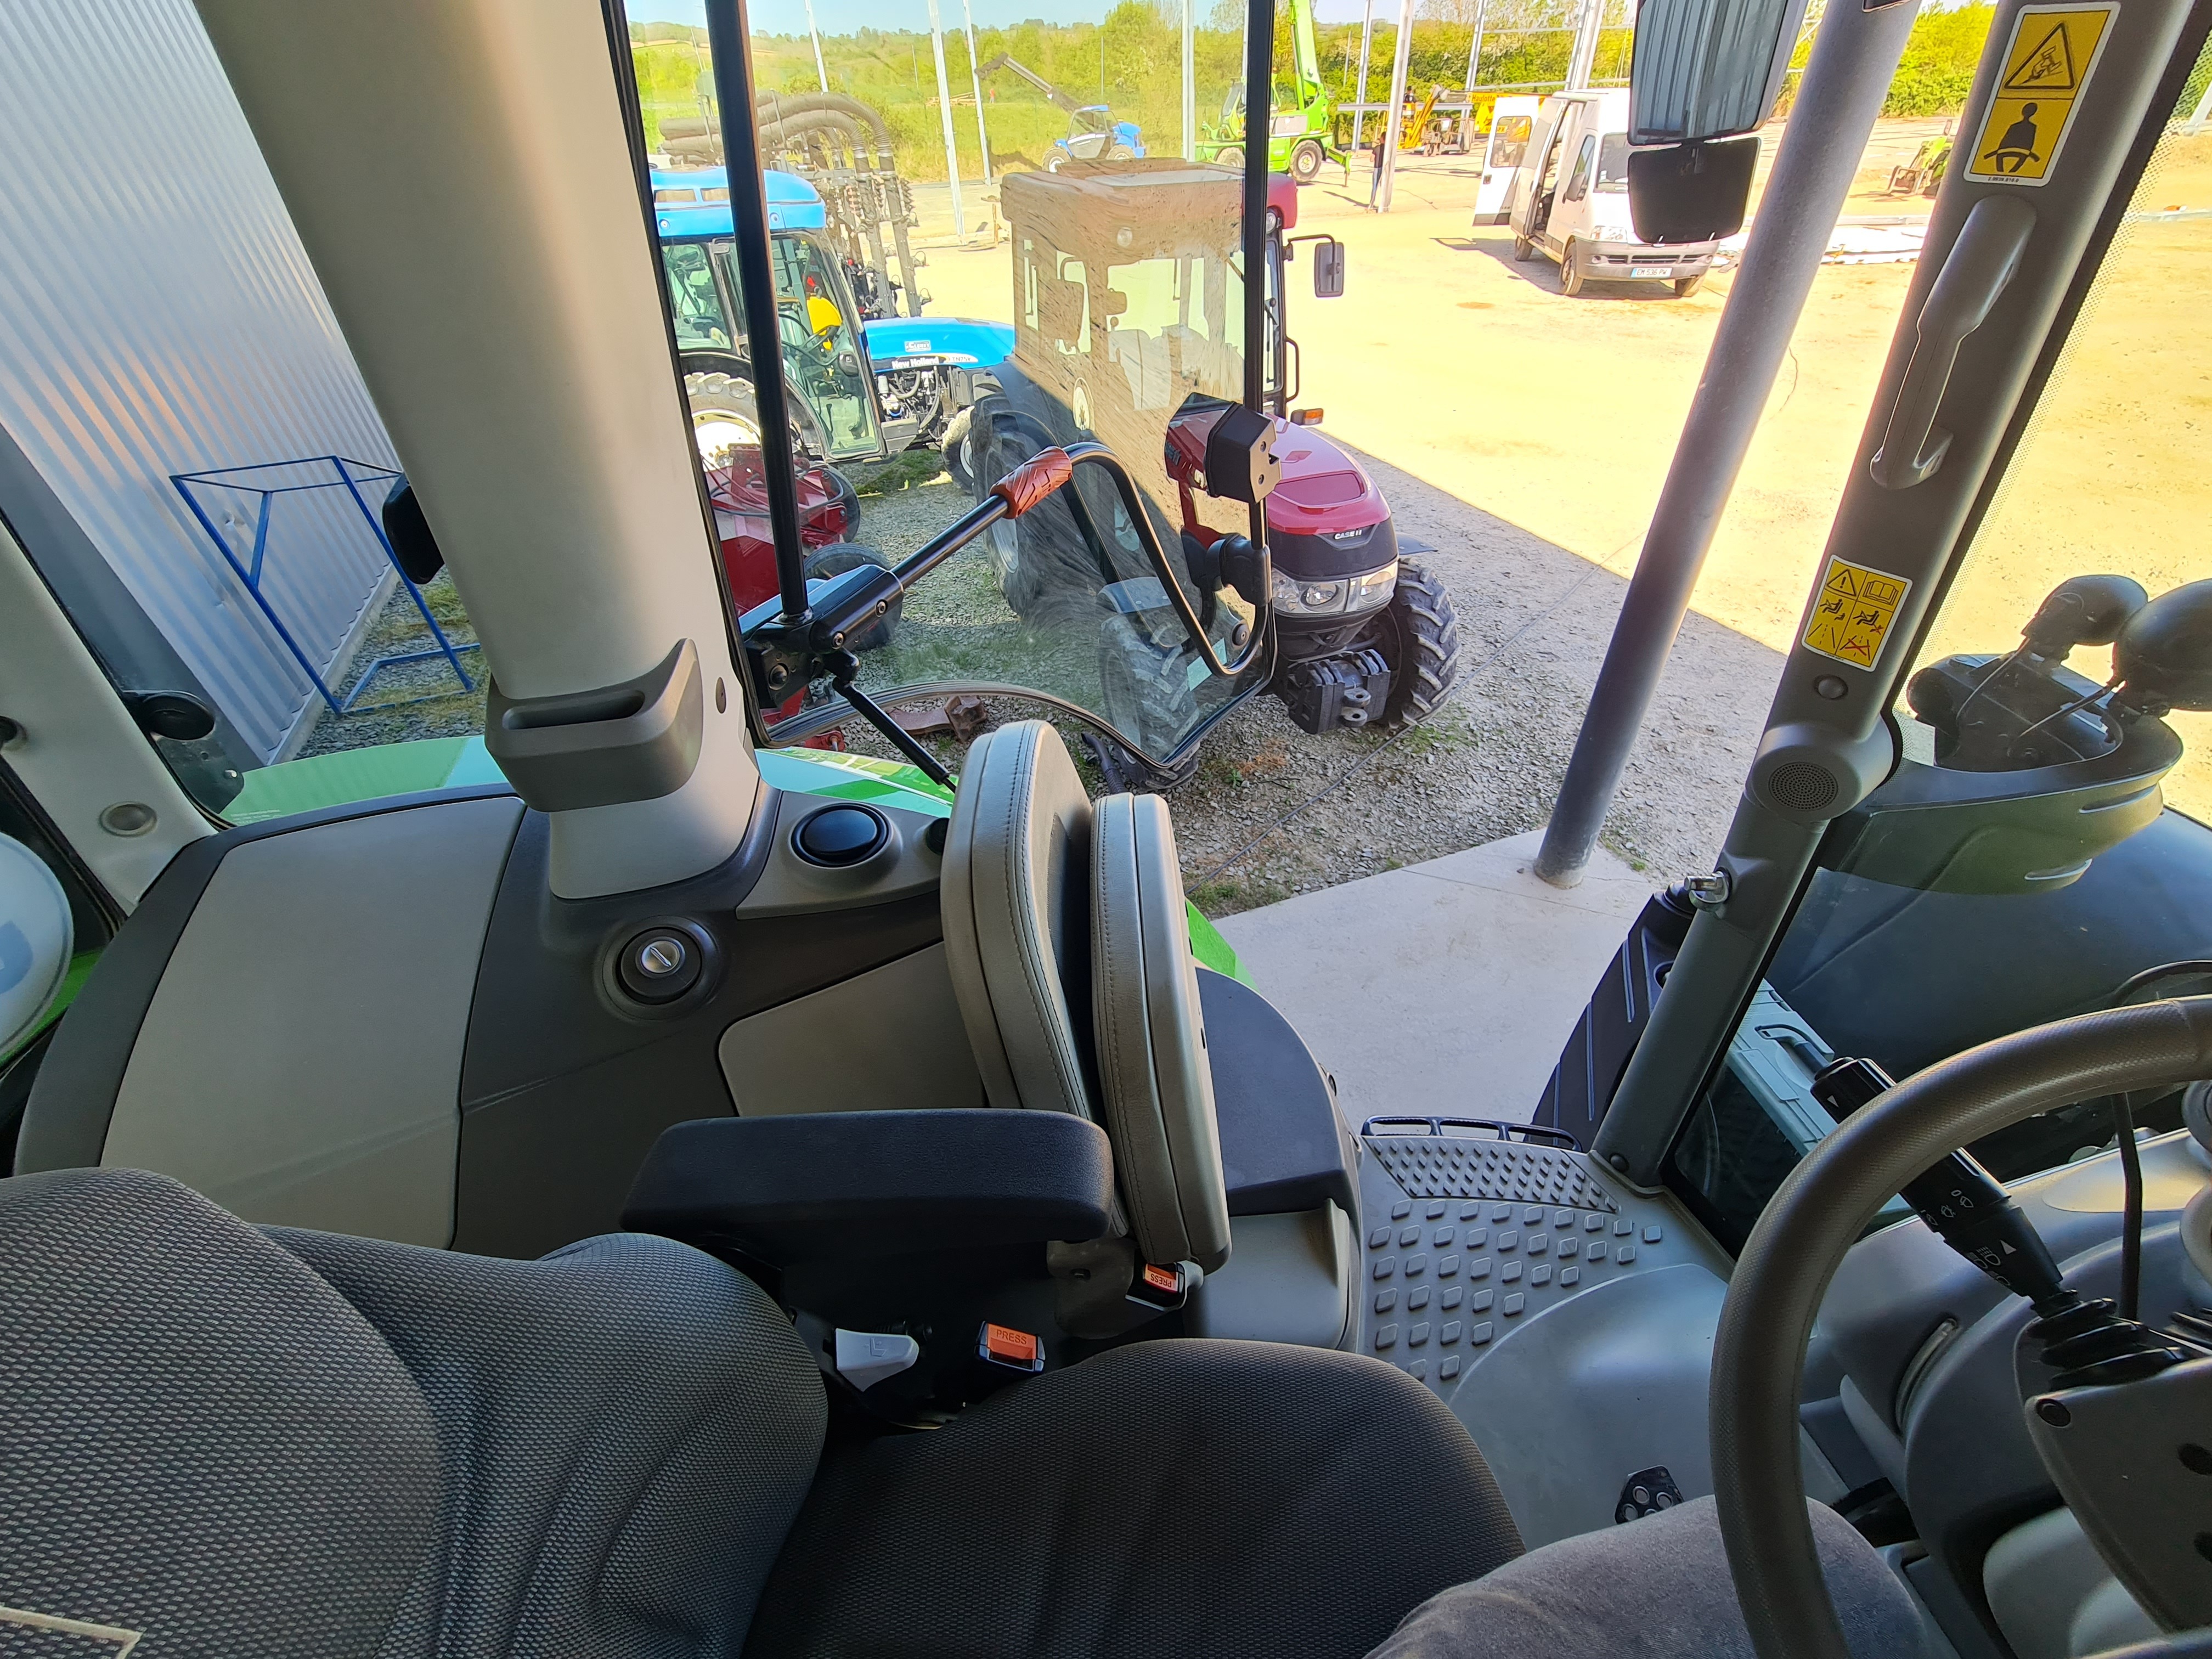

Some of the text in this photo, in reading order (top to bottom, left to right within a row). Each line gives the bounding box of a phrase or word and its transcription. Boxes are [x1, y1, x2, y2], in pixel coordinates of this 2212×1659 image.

[891, 356, 939, 369] New Holland
[1334, 531, 1355, 540] CASE
[1150, 1273, 1172, 1288] PRESS
[996, 1329, 1026, 1345] PRESS
